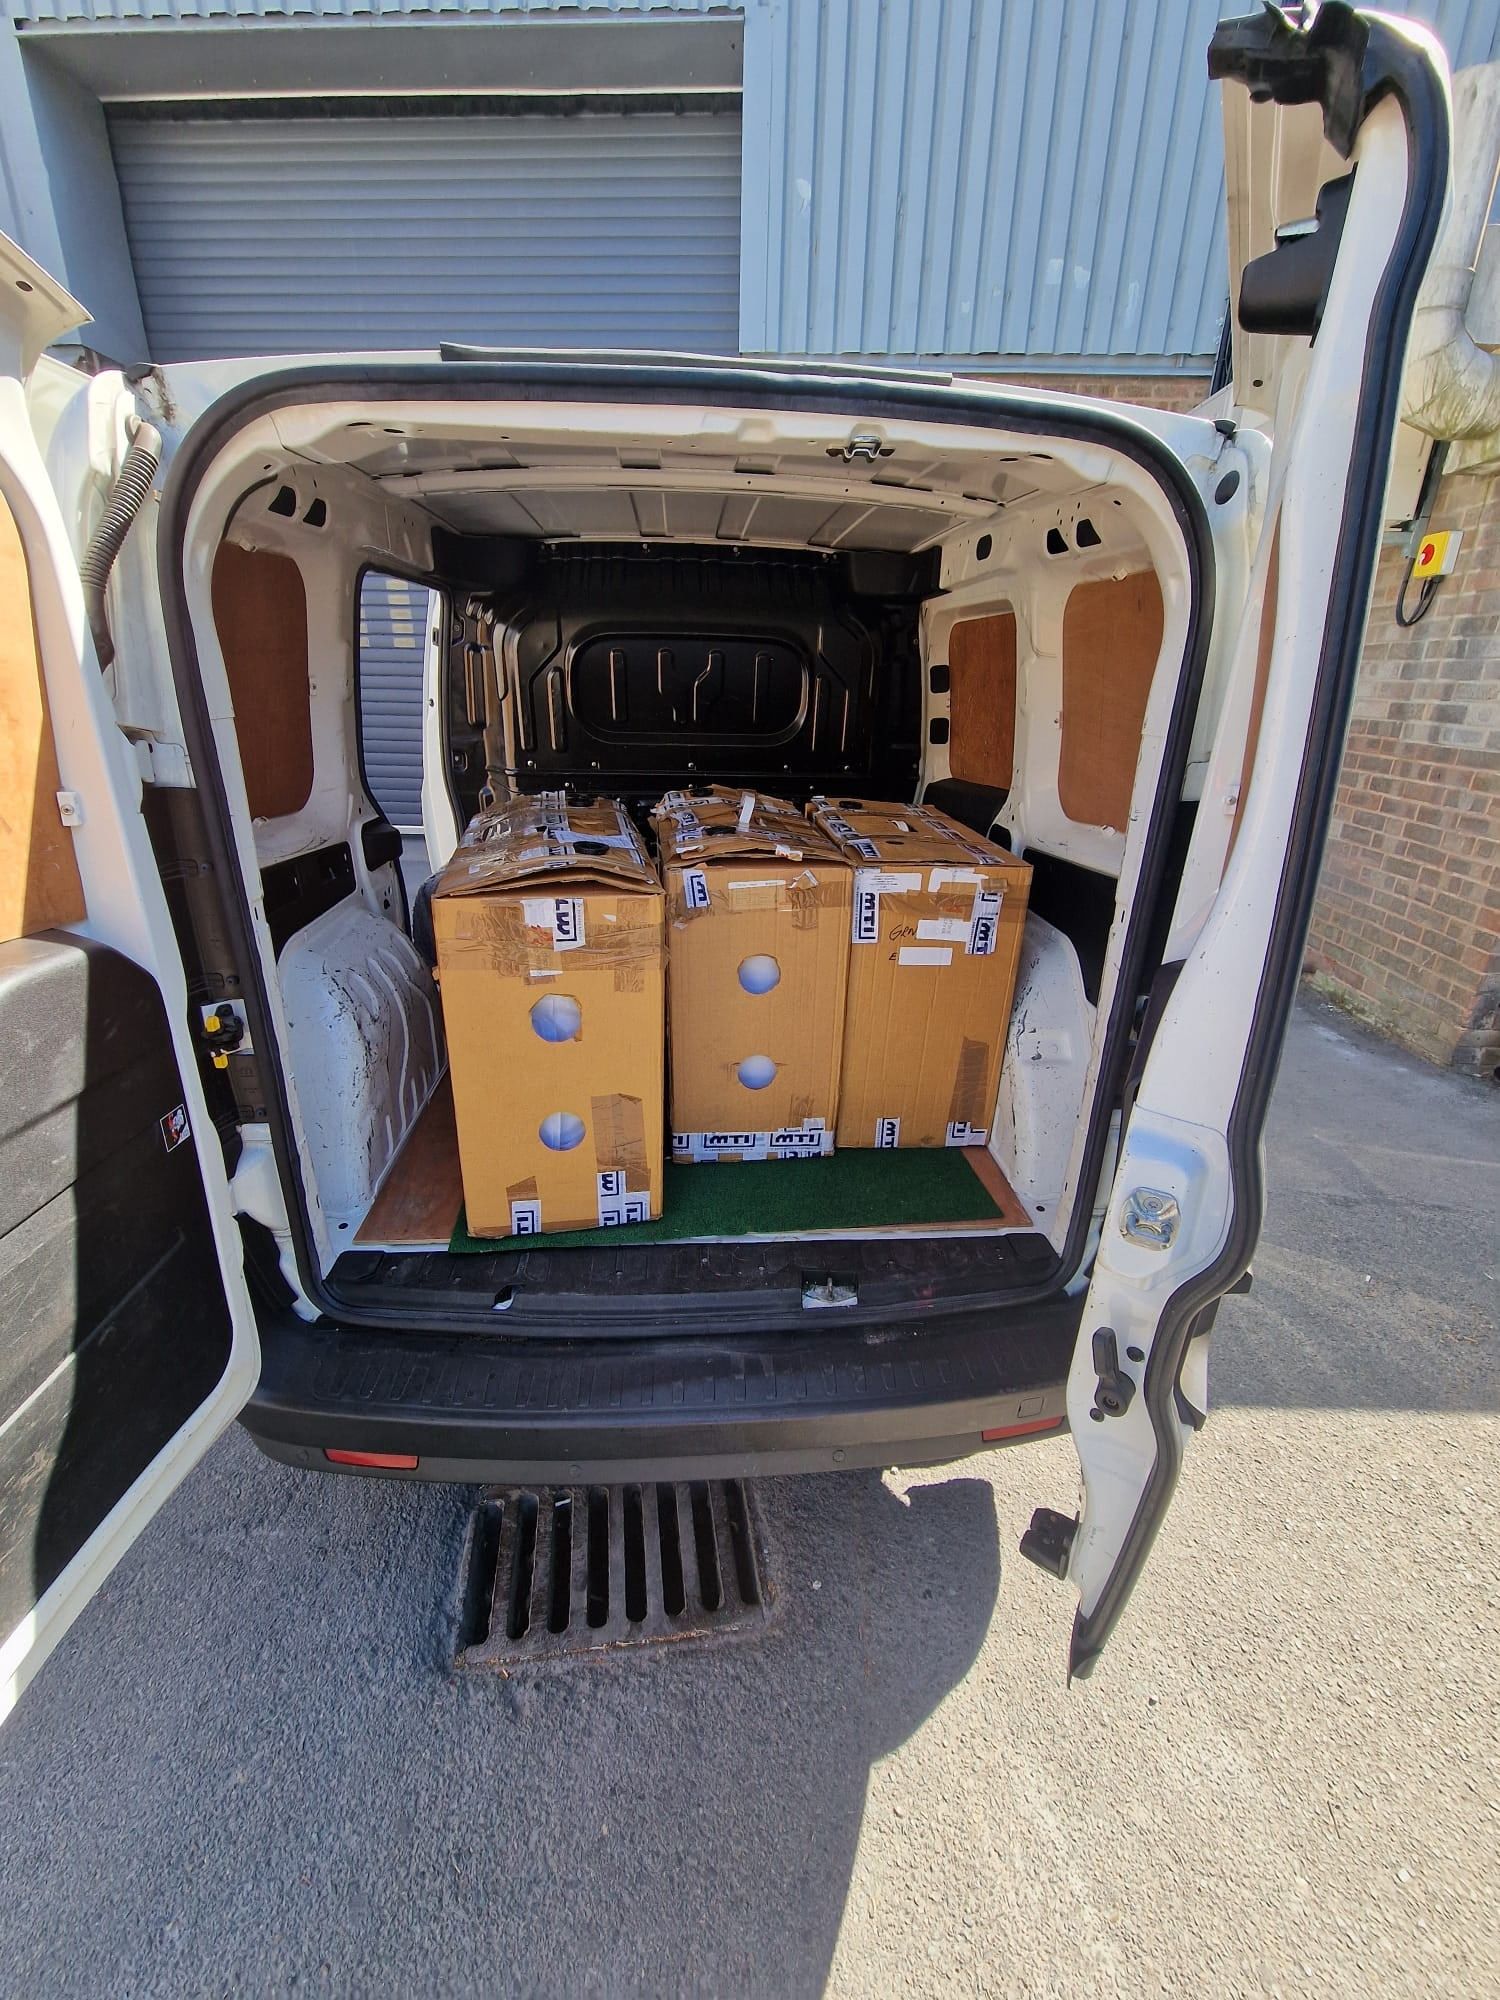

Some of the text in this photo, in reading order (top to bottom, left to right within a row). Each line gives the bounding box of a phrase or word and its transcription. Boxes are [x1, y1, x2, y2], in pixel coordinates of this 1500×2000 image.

[863, 892, 876, 933] MTI
[709, 1135, 750, 1145] MTI
[775, 1133, 815, 1143] MTI
